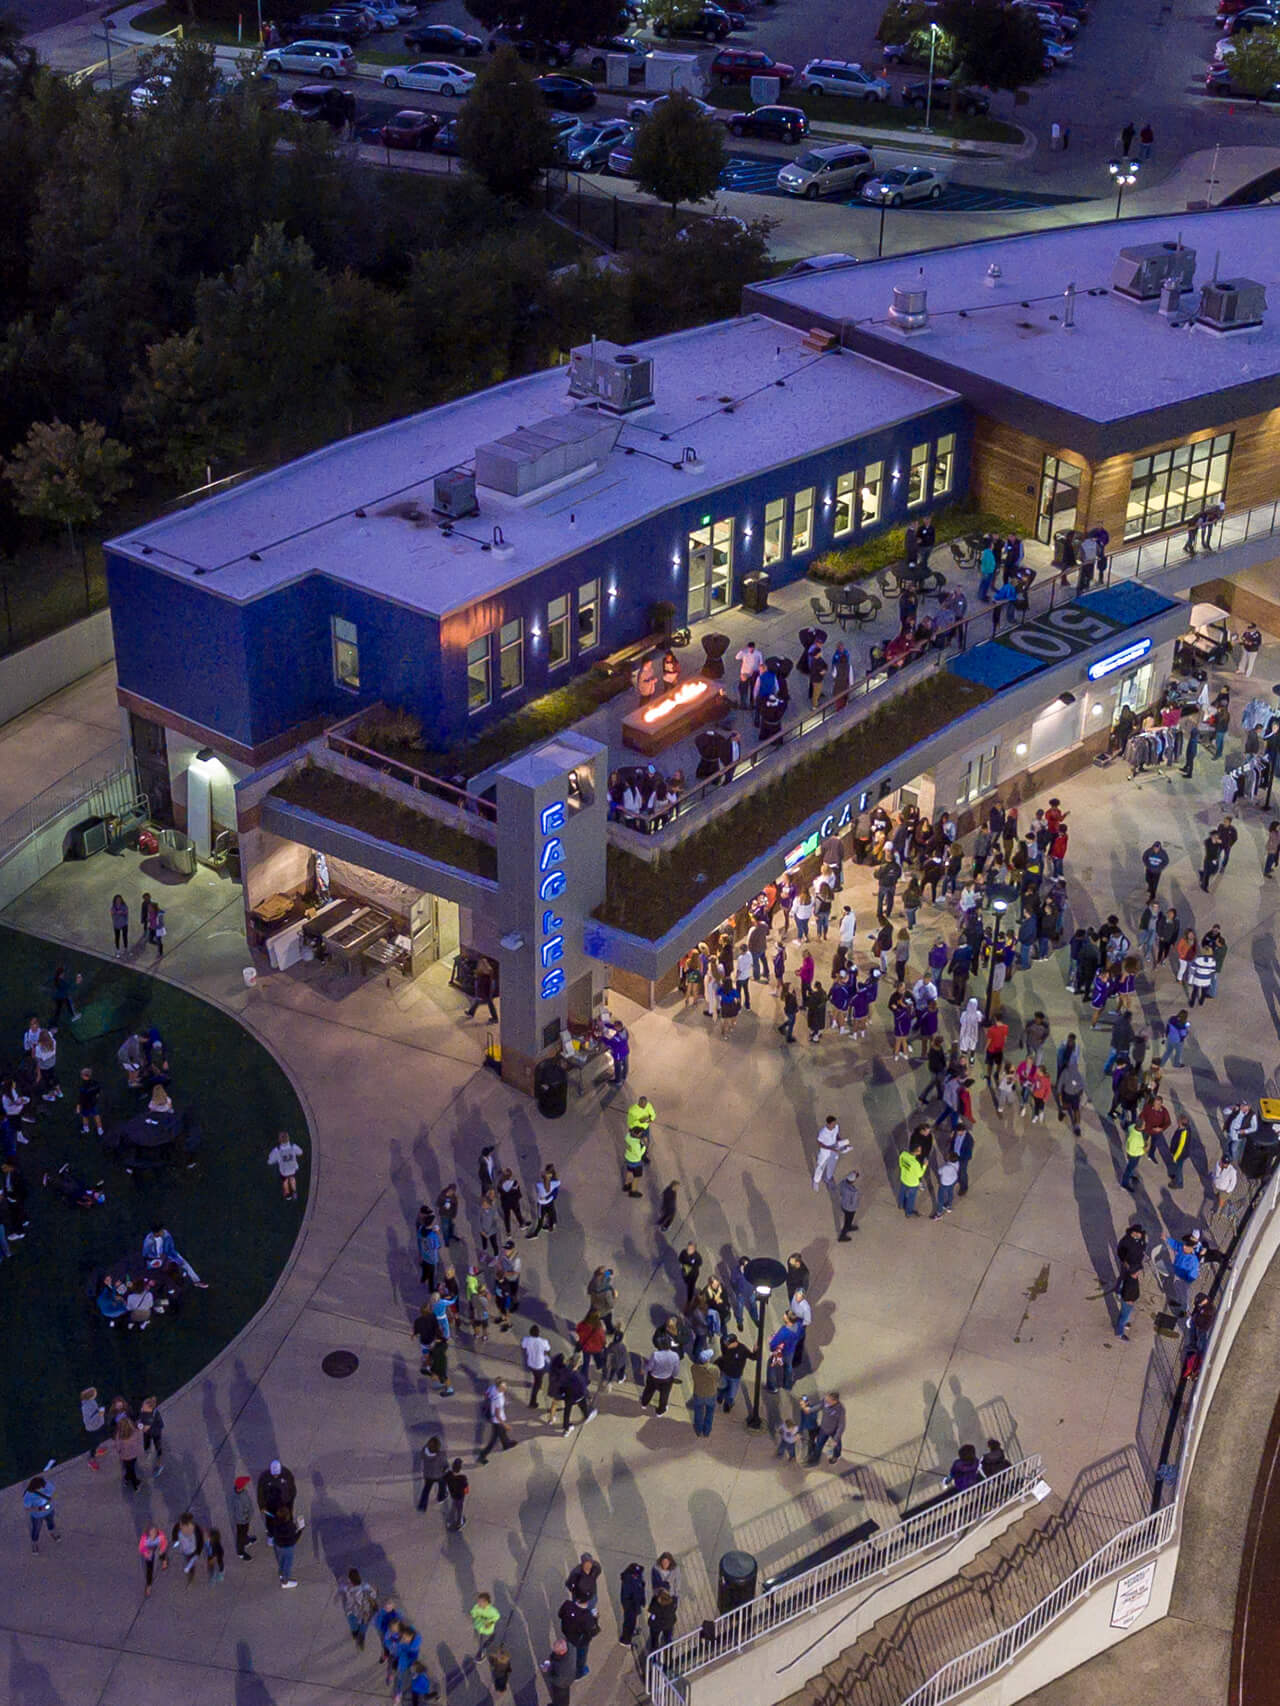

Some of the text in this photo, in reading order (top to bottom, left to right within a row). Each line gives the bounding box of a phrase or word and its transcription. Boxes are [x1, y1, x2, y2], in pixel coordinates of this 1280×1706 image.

[1009, 608, 1116, 658] 50
[821, 777, 892, 838] CAFE
[539, 801, 568, 1000] EAGLES
